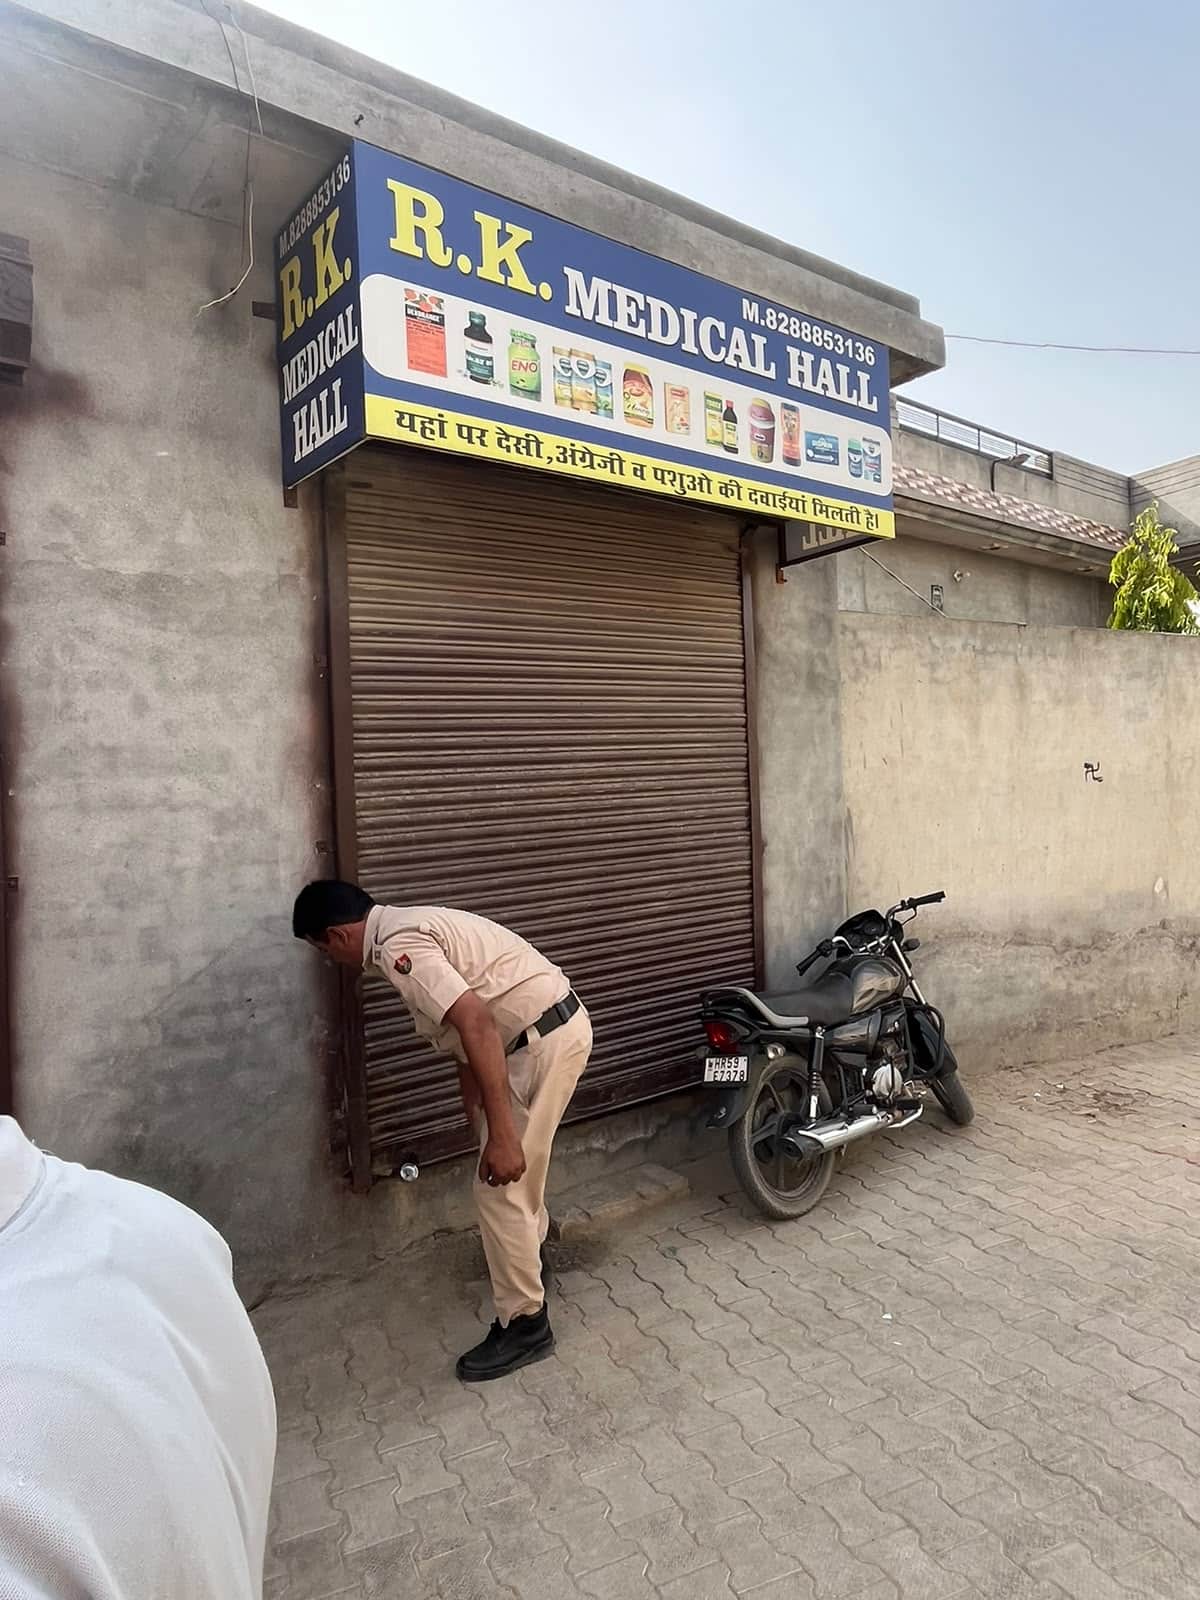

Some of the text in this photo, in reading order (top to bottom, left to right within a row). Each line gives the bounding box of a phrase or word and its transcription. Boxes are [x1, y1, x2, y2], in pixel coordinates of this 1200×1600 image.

[280, 154, 350, 259] M.8288853136
[280, 207, 352, 342] R.K.
[387, 178, 878, 412] R.K. MEDICAL HALL
[282, 304, 358, 404] MEDICAL
[511, 360, 538, 373] ENO
[742, 298, 875, 366] M.8288853136
[292, 378, 348, 463] HALL
[394, 410, 448, 441] यहां
[456, 423, 489, 447] पर
[632, 462, 647, 480] व
[718, 479, 743, 501] की
[812, 498, 861, 525] मिलती
[714, 1057, 739, 1069] HR59
